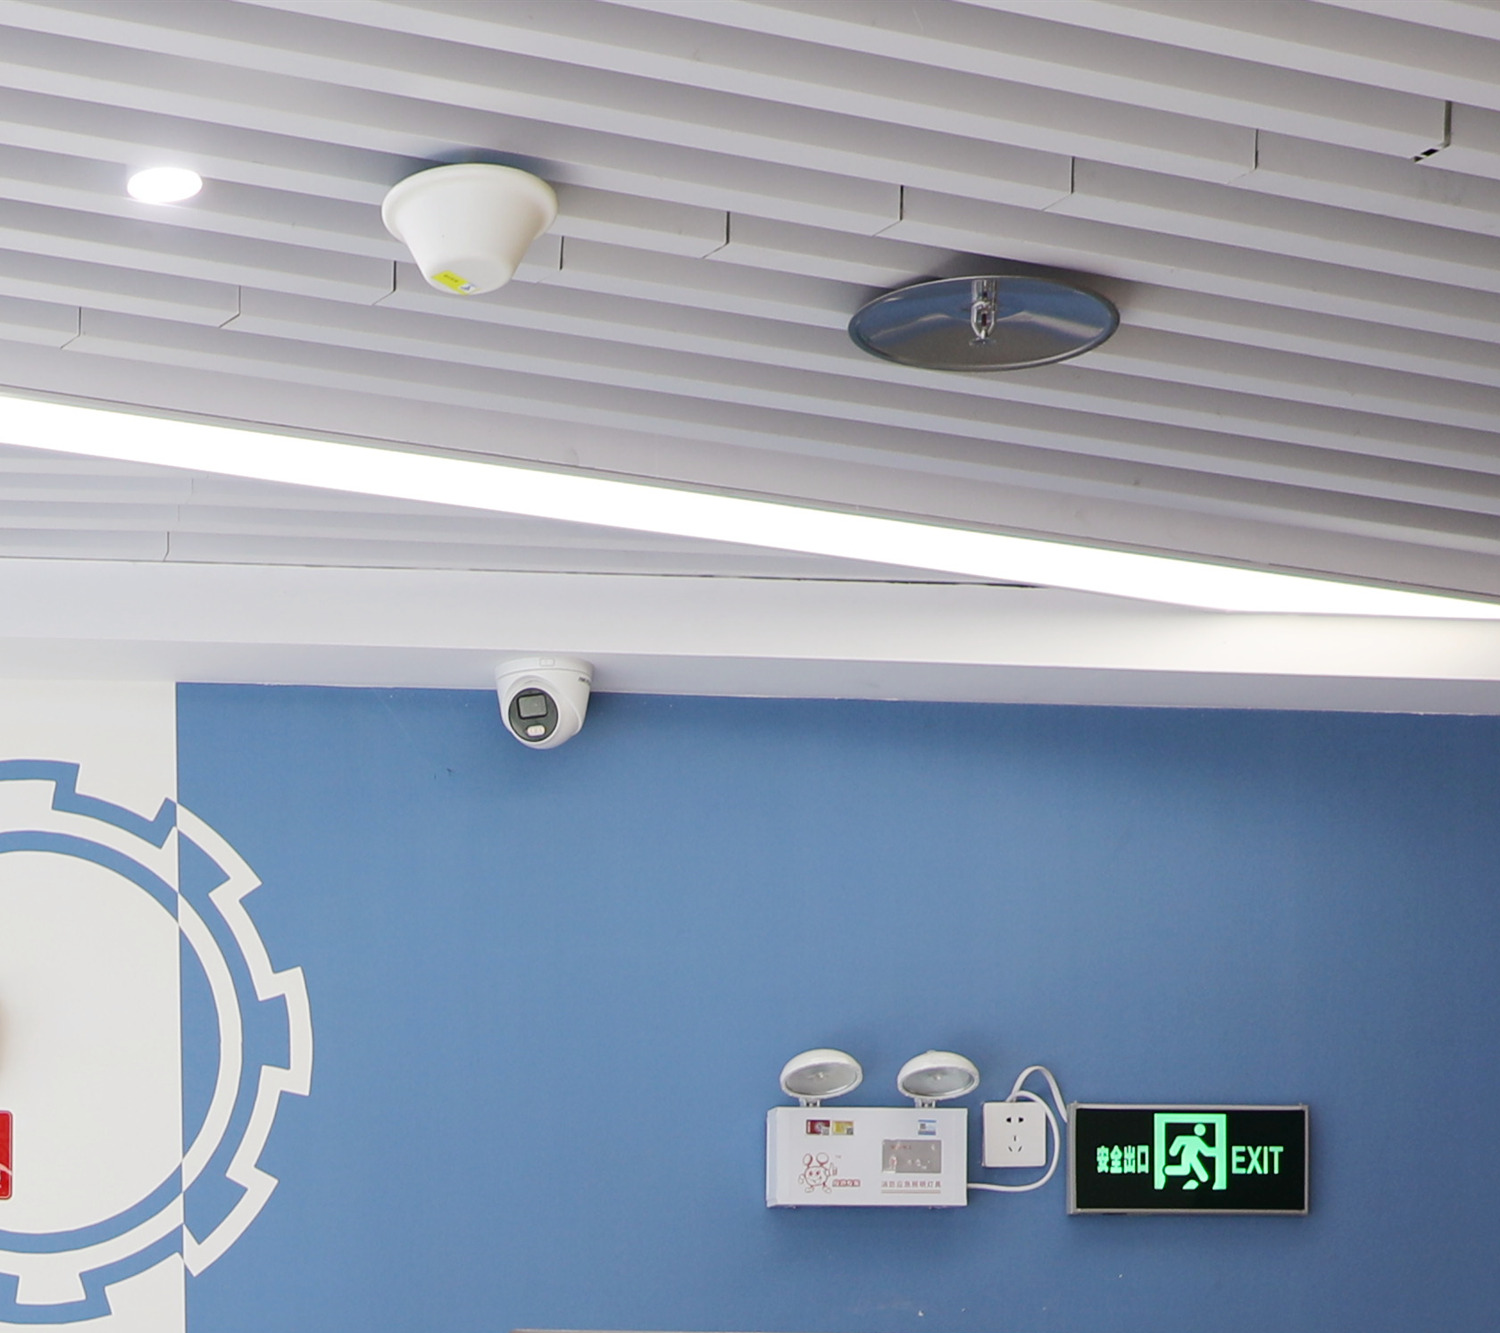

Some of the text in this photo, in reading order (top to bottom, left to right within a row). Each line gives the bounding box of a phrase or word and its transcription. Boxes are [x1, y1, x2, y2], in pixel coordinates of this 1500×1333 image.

[1096, 1144, 1150, 1174] 安全出口
[1231, 1145, 1284, 1175] EXIT
